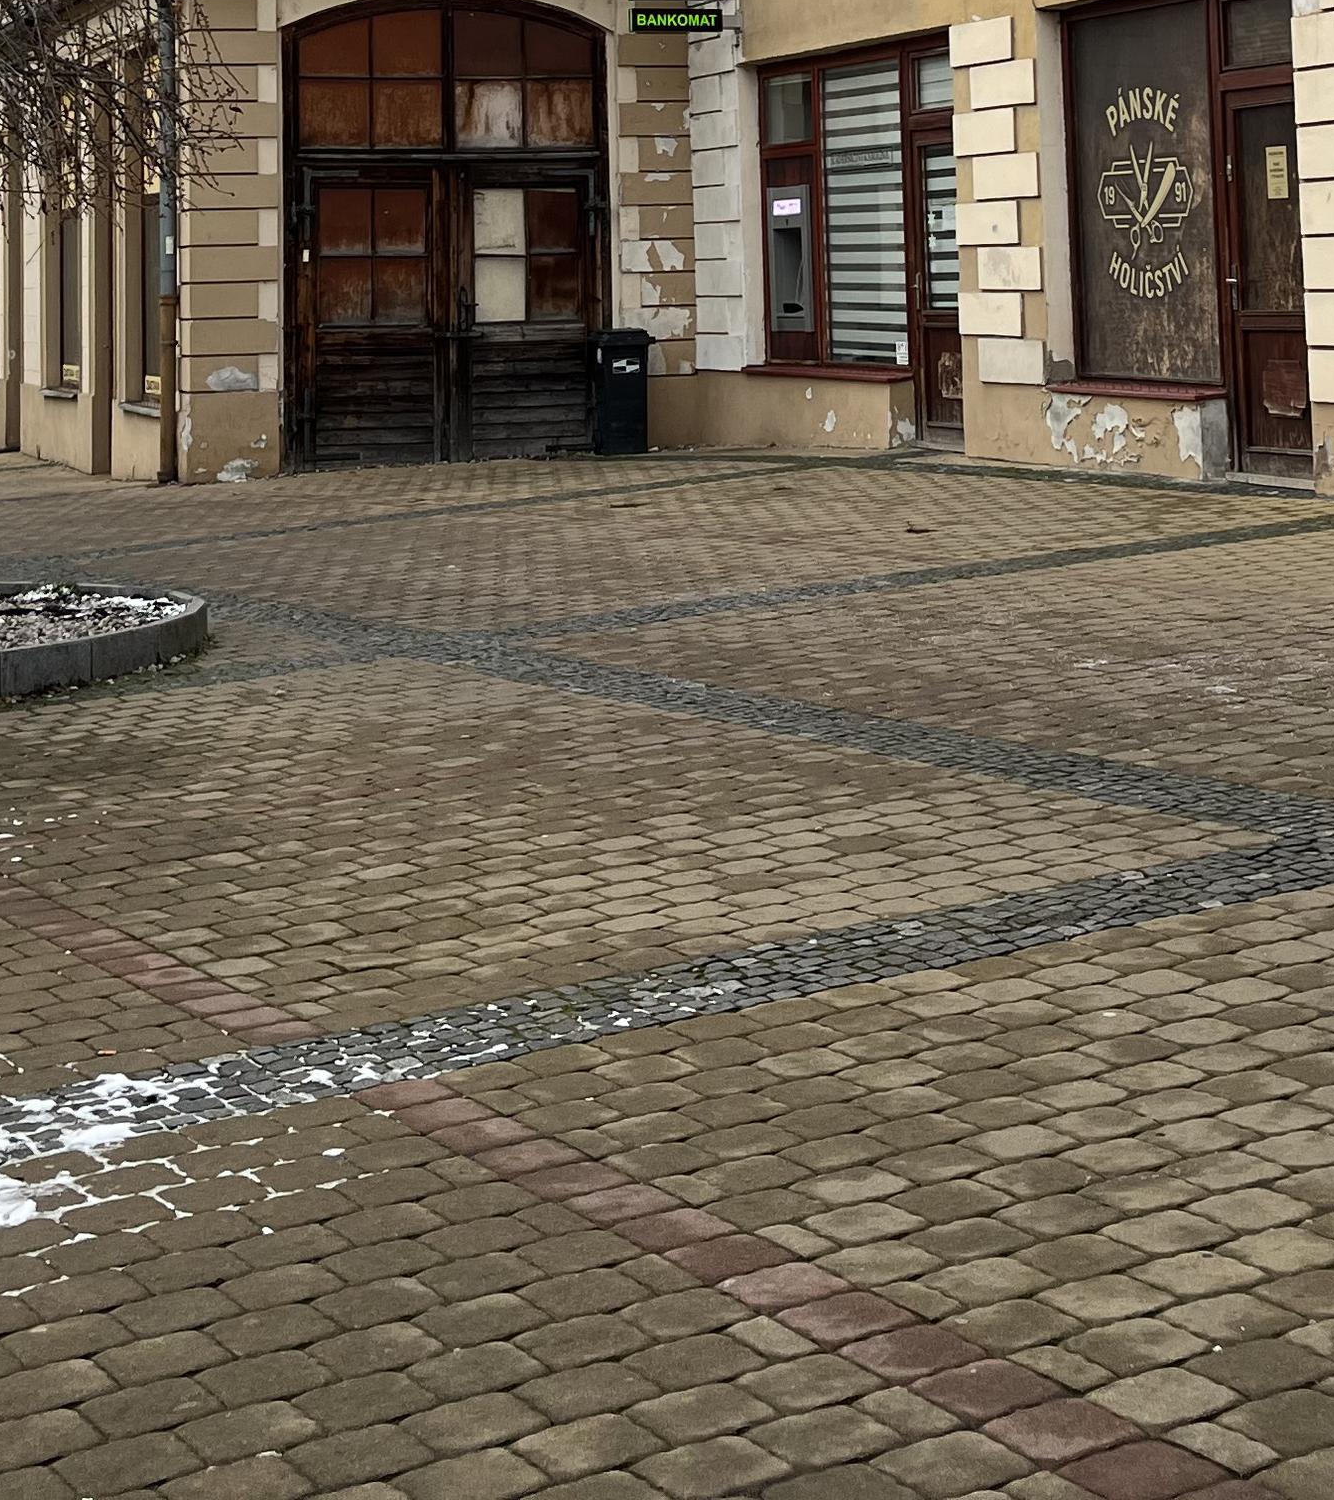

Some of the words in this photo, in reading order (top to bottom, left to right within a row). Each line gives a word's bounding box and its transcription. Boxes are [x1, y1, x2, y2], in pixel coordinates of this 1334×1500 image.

[636, 13, 718, 28] BANKOMAT
[1105, 86, 1180, 138] PÁNSKÉ
[1104, 185, 1116, 206] 19
[1175, 181, 1187, 203] 91
[1108, 244, 1190, 299] HOLIČSTVÍ
